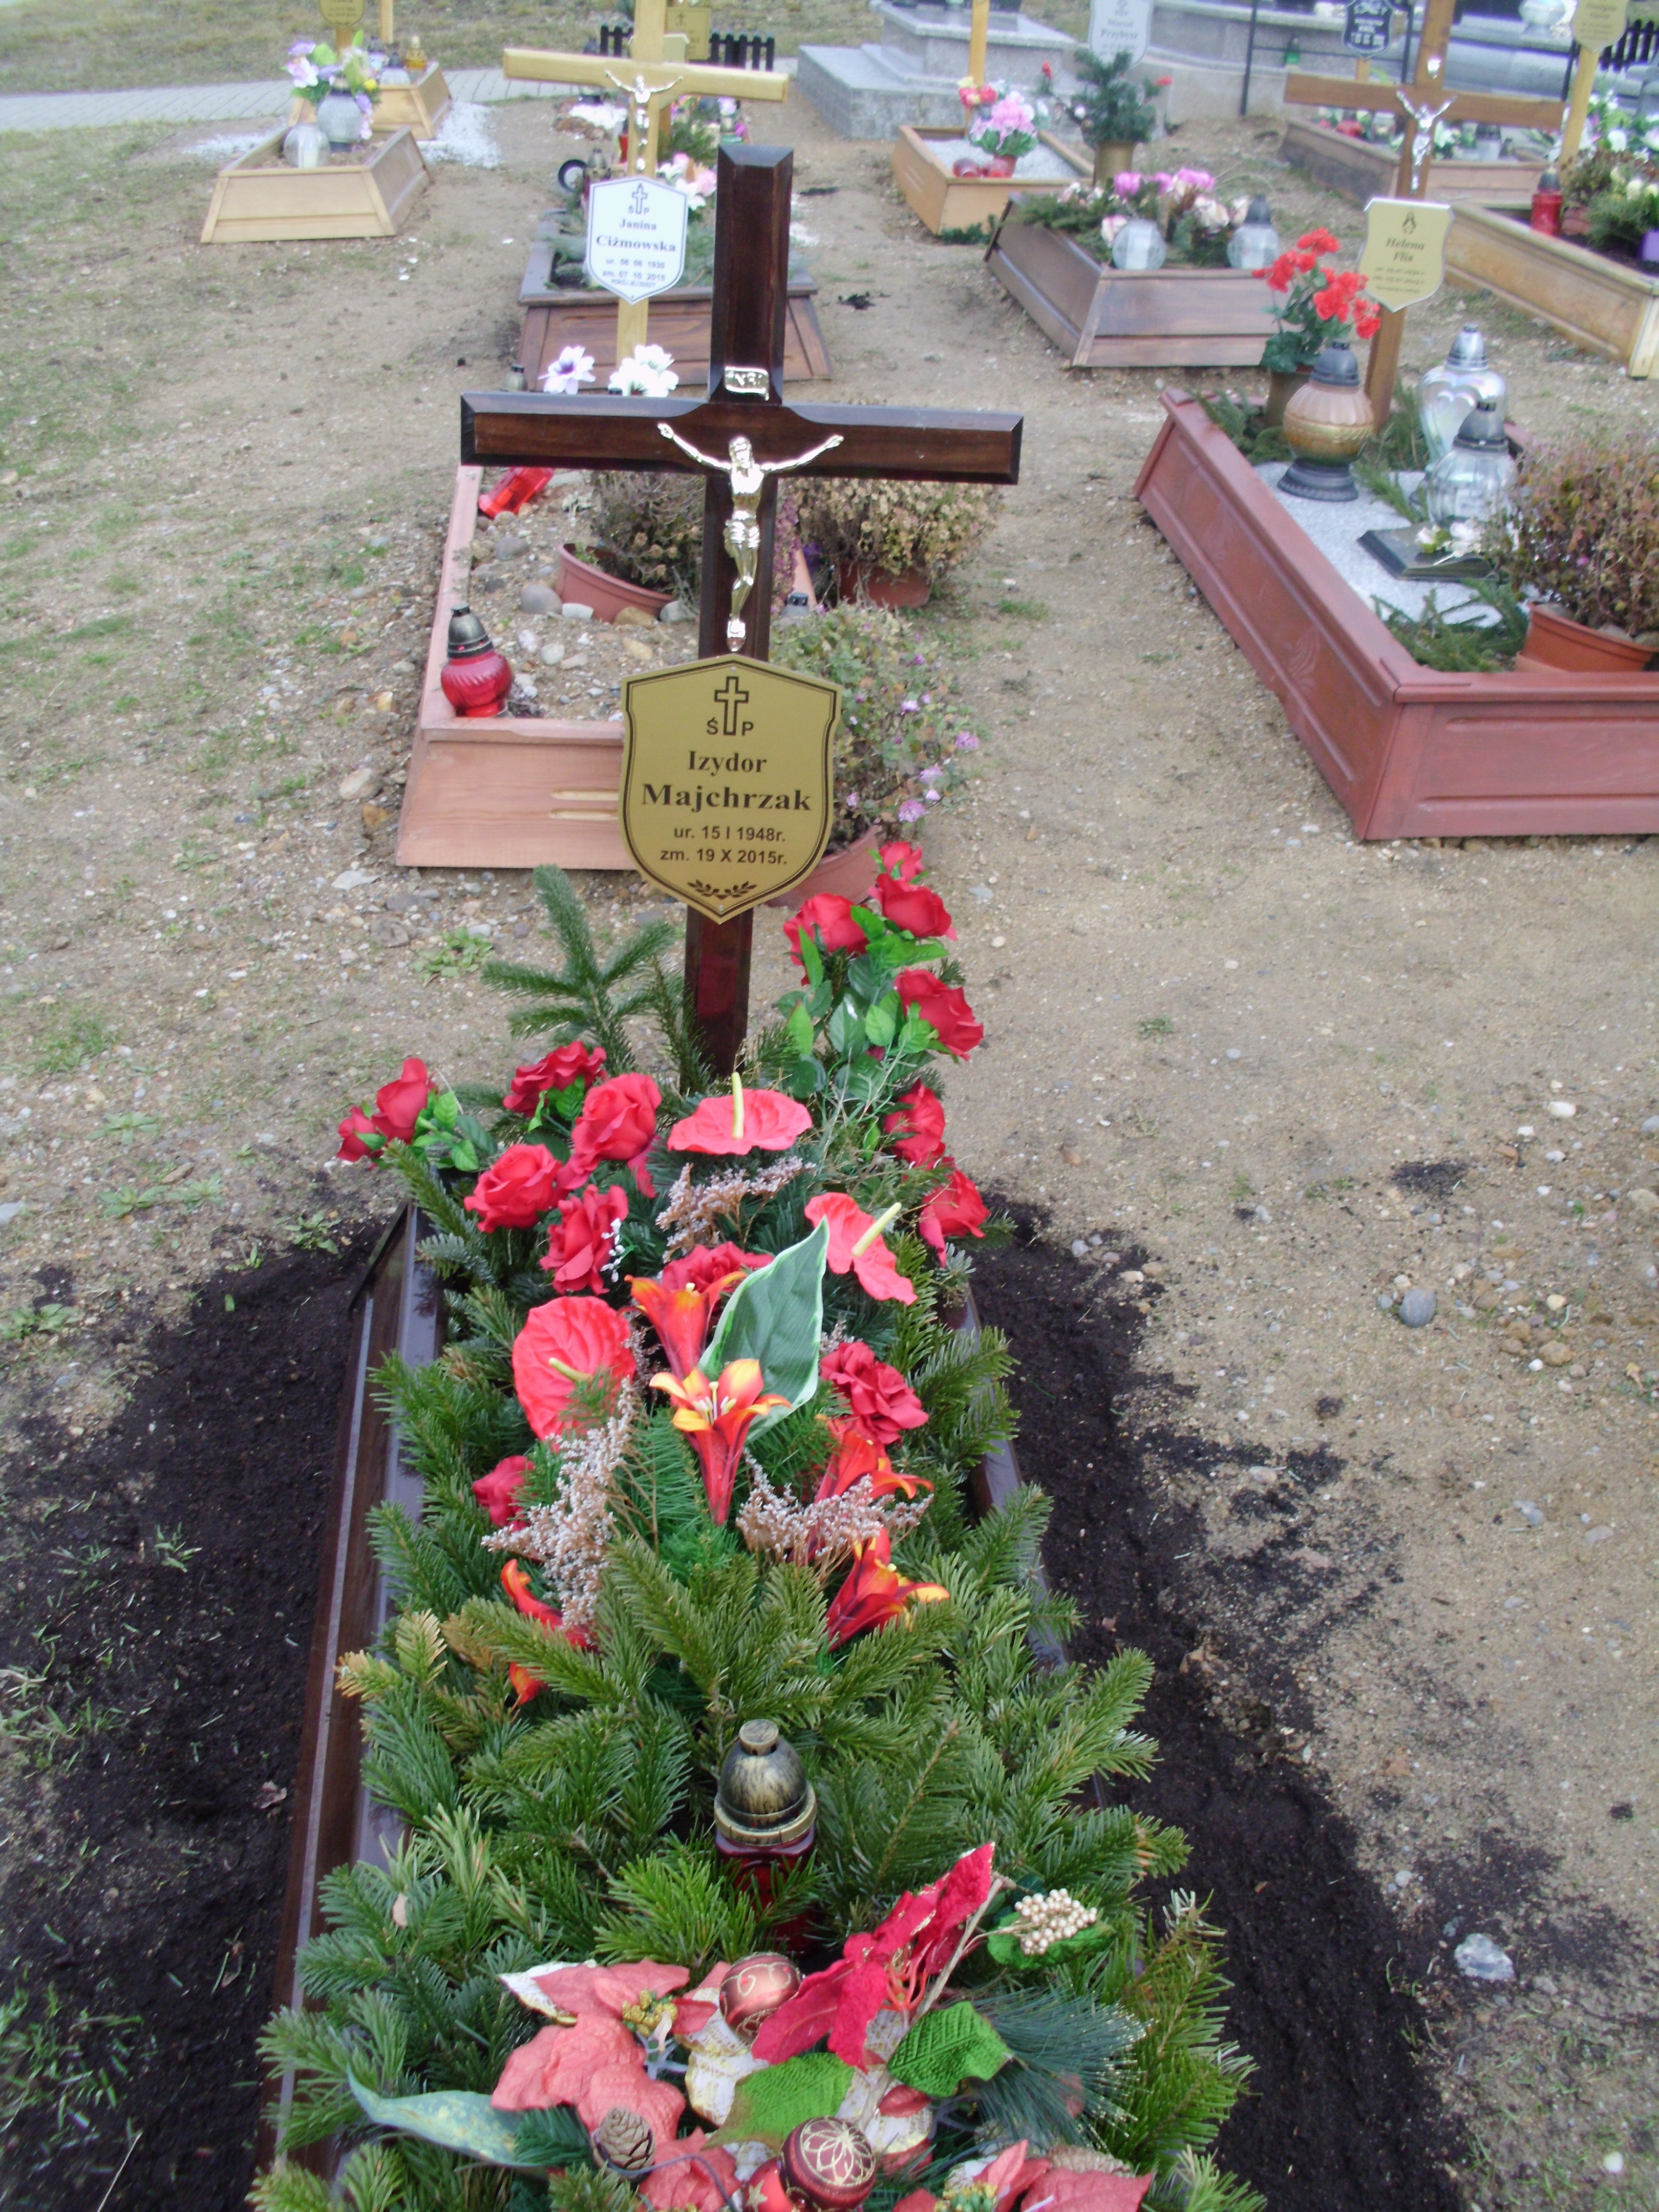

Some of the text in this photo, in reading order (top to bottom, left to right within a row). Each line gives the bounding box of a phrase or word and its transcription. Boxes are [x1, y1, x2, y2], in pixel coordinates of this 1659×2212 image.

[620, 219, 656, 230] Janina
[597, 235, 676, 252] Ciżmowska
[1386, 238, 1425, 250] Helena
[707, 717, 754, 736] Ś P
[688, 750, 768, 777] Izydor
[641, 783, 812, 813] Majchrzak
[674, 826, 786, 842] ur. 15 I 1948r.
[661, 848, 788, 865] zm. 19 X 2015r.
